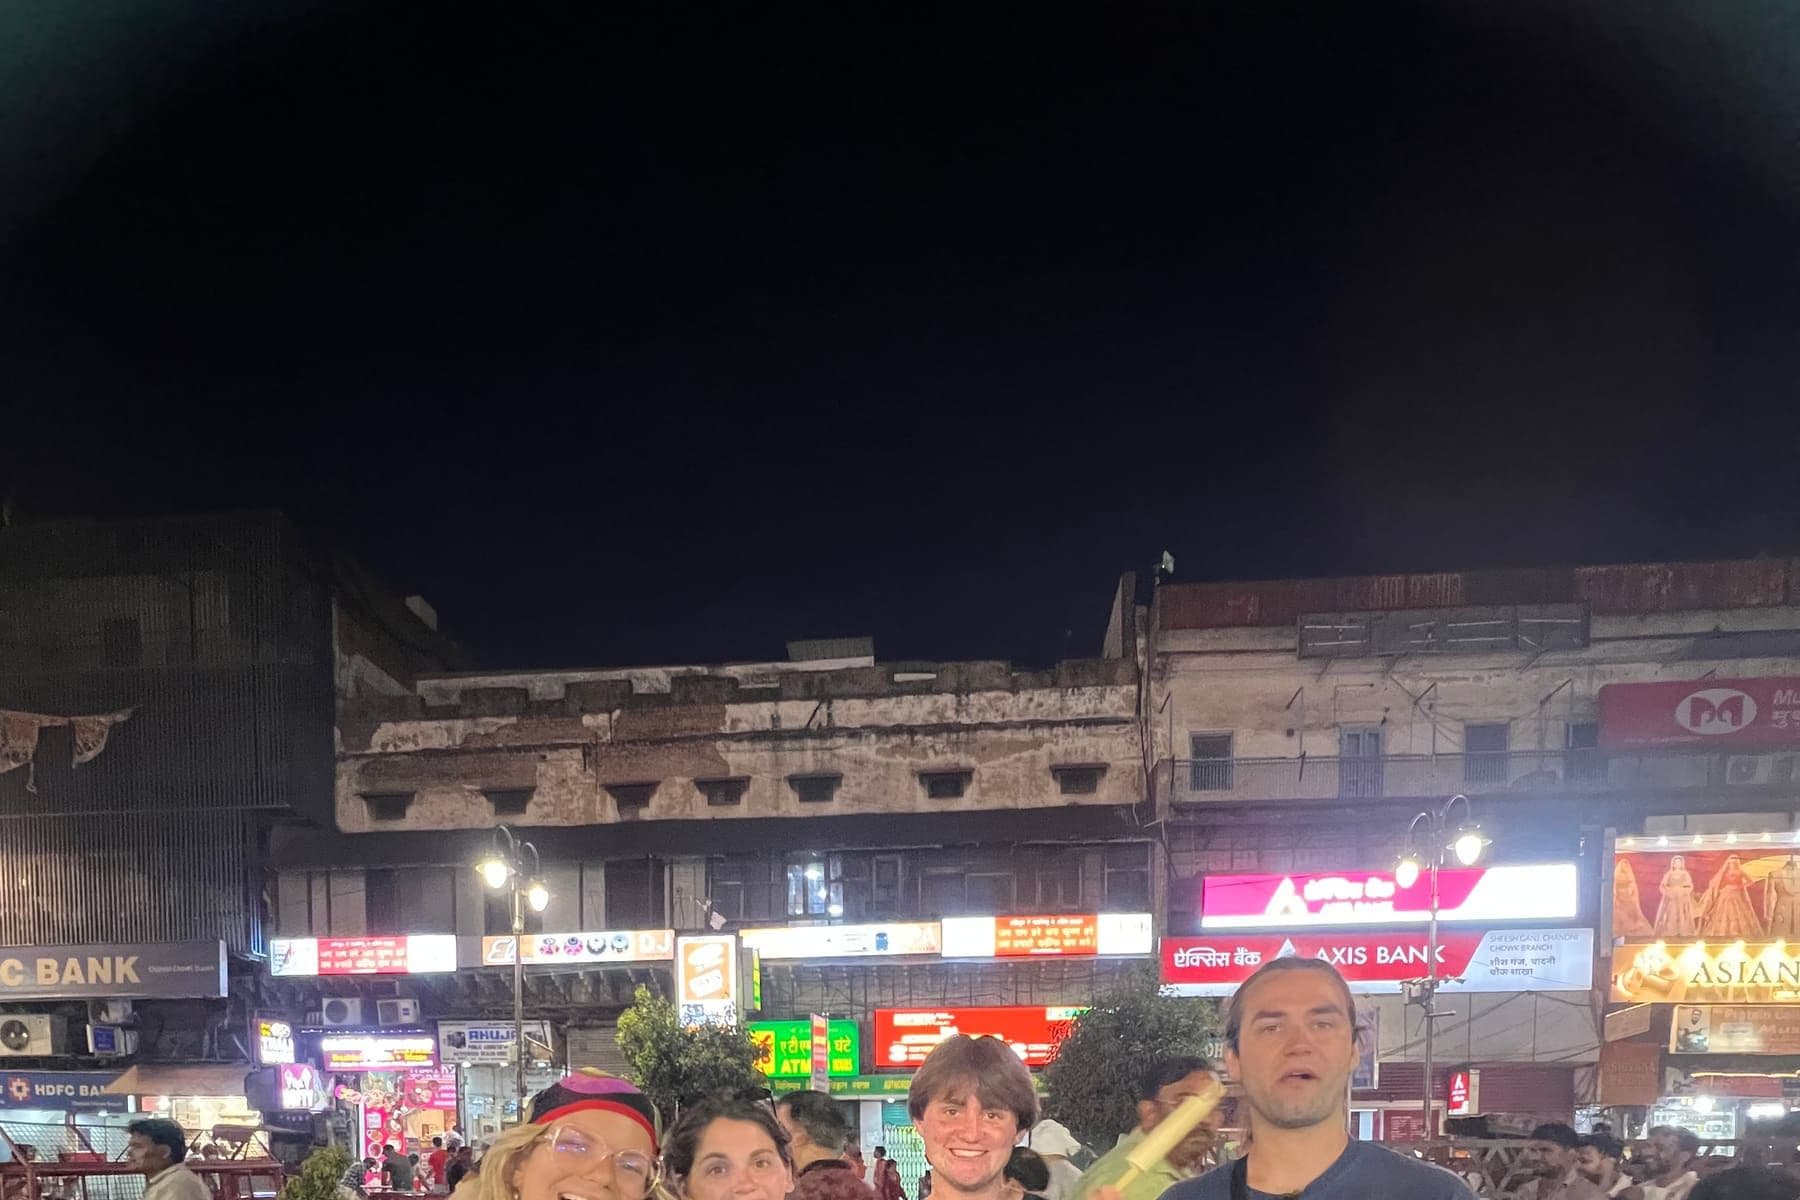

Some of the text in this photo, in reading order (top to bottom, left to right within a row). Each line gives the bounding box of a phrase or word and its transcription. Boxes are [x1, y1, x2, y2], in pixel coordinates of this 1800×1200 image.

[1173, 946, 1261, 967] ऐक्सिस बैंक
[1316, 945, 1446, 965] AXIS BANK
[1489, 943, 1553, 952] CHOWK BRANCH
[36, 956, 141, 985] BANK
[1690, 961, 1800, 984] ASIAN
[34, 1084, 75, 1096] HDFC
